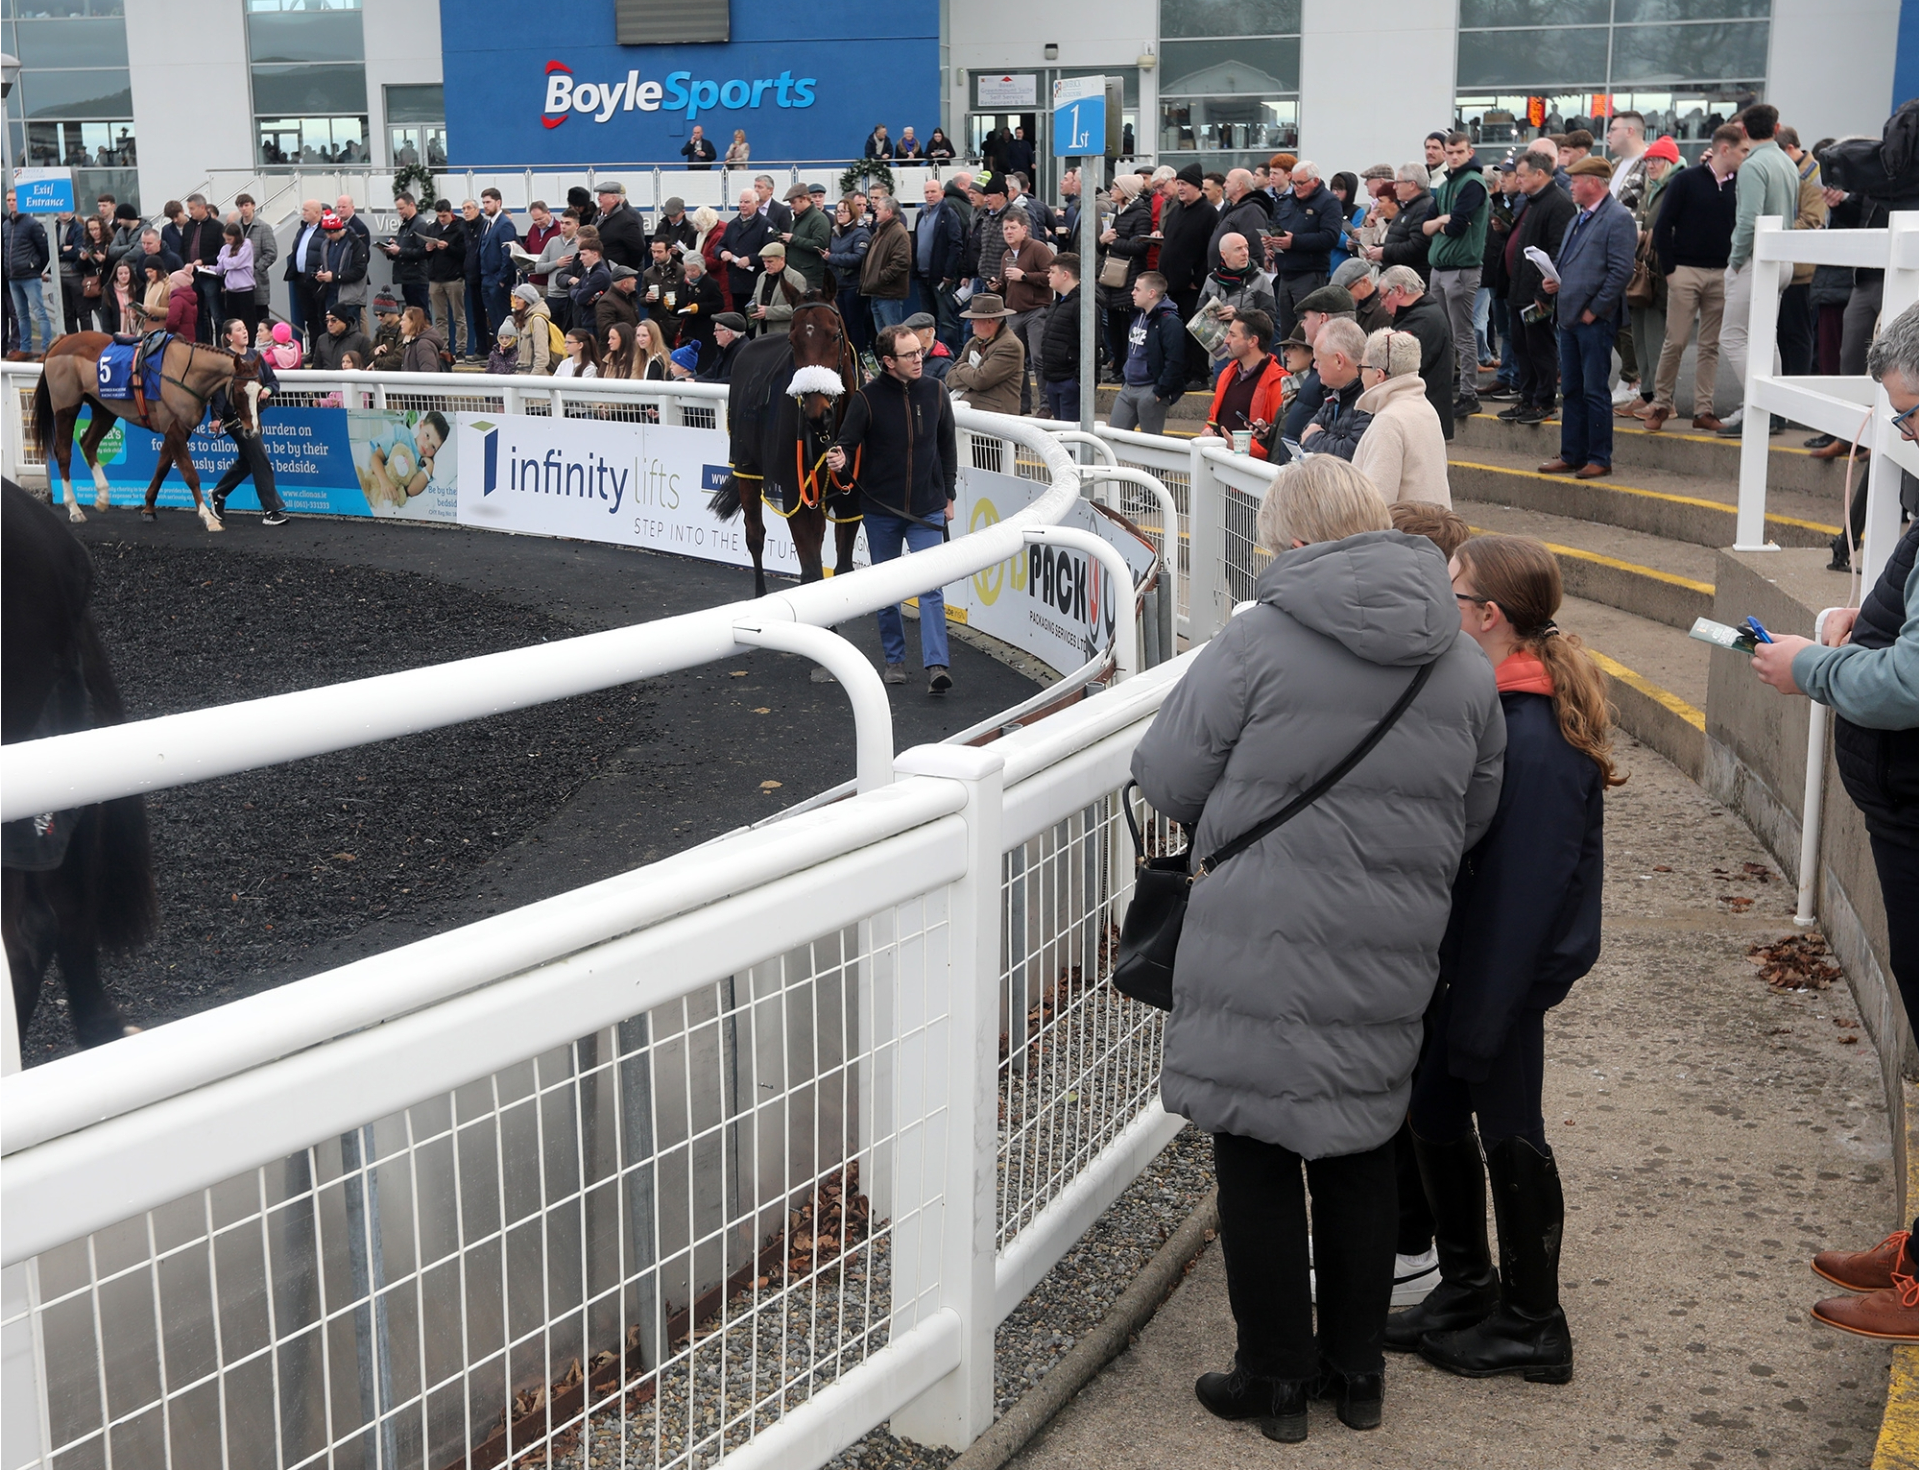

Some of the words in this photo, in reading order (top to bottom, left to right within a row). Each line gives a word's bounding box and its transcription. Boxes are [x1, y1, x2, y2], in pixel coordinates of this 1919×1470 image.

[545, 70, 817, 122] BoyleSports
[1068, 104, 1089, 149] 1st
[33, 183, 54, 197] Exit/
[26, 197, 65, 208] Entrance
[99, 356, 112, 384] 5
[298, 426, 312, 436] on
[197, 441, 209, 452] to
[272, 441, 286, 454] be
[287, 441, 301, 458] by
[302, 442, 329, 456] their
[275, 459, 319, 474] bedside.
[510, 446, 629, 515] infinity
[633, 456, 681, 511] lifts
[634, 517, 664, 538] STEP
[670, 523, 705, 546] INTO
[711, 529, 739, 552] THE
